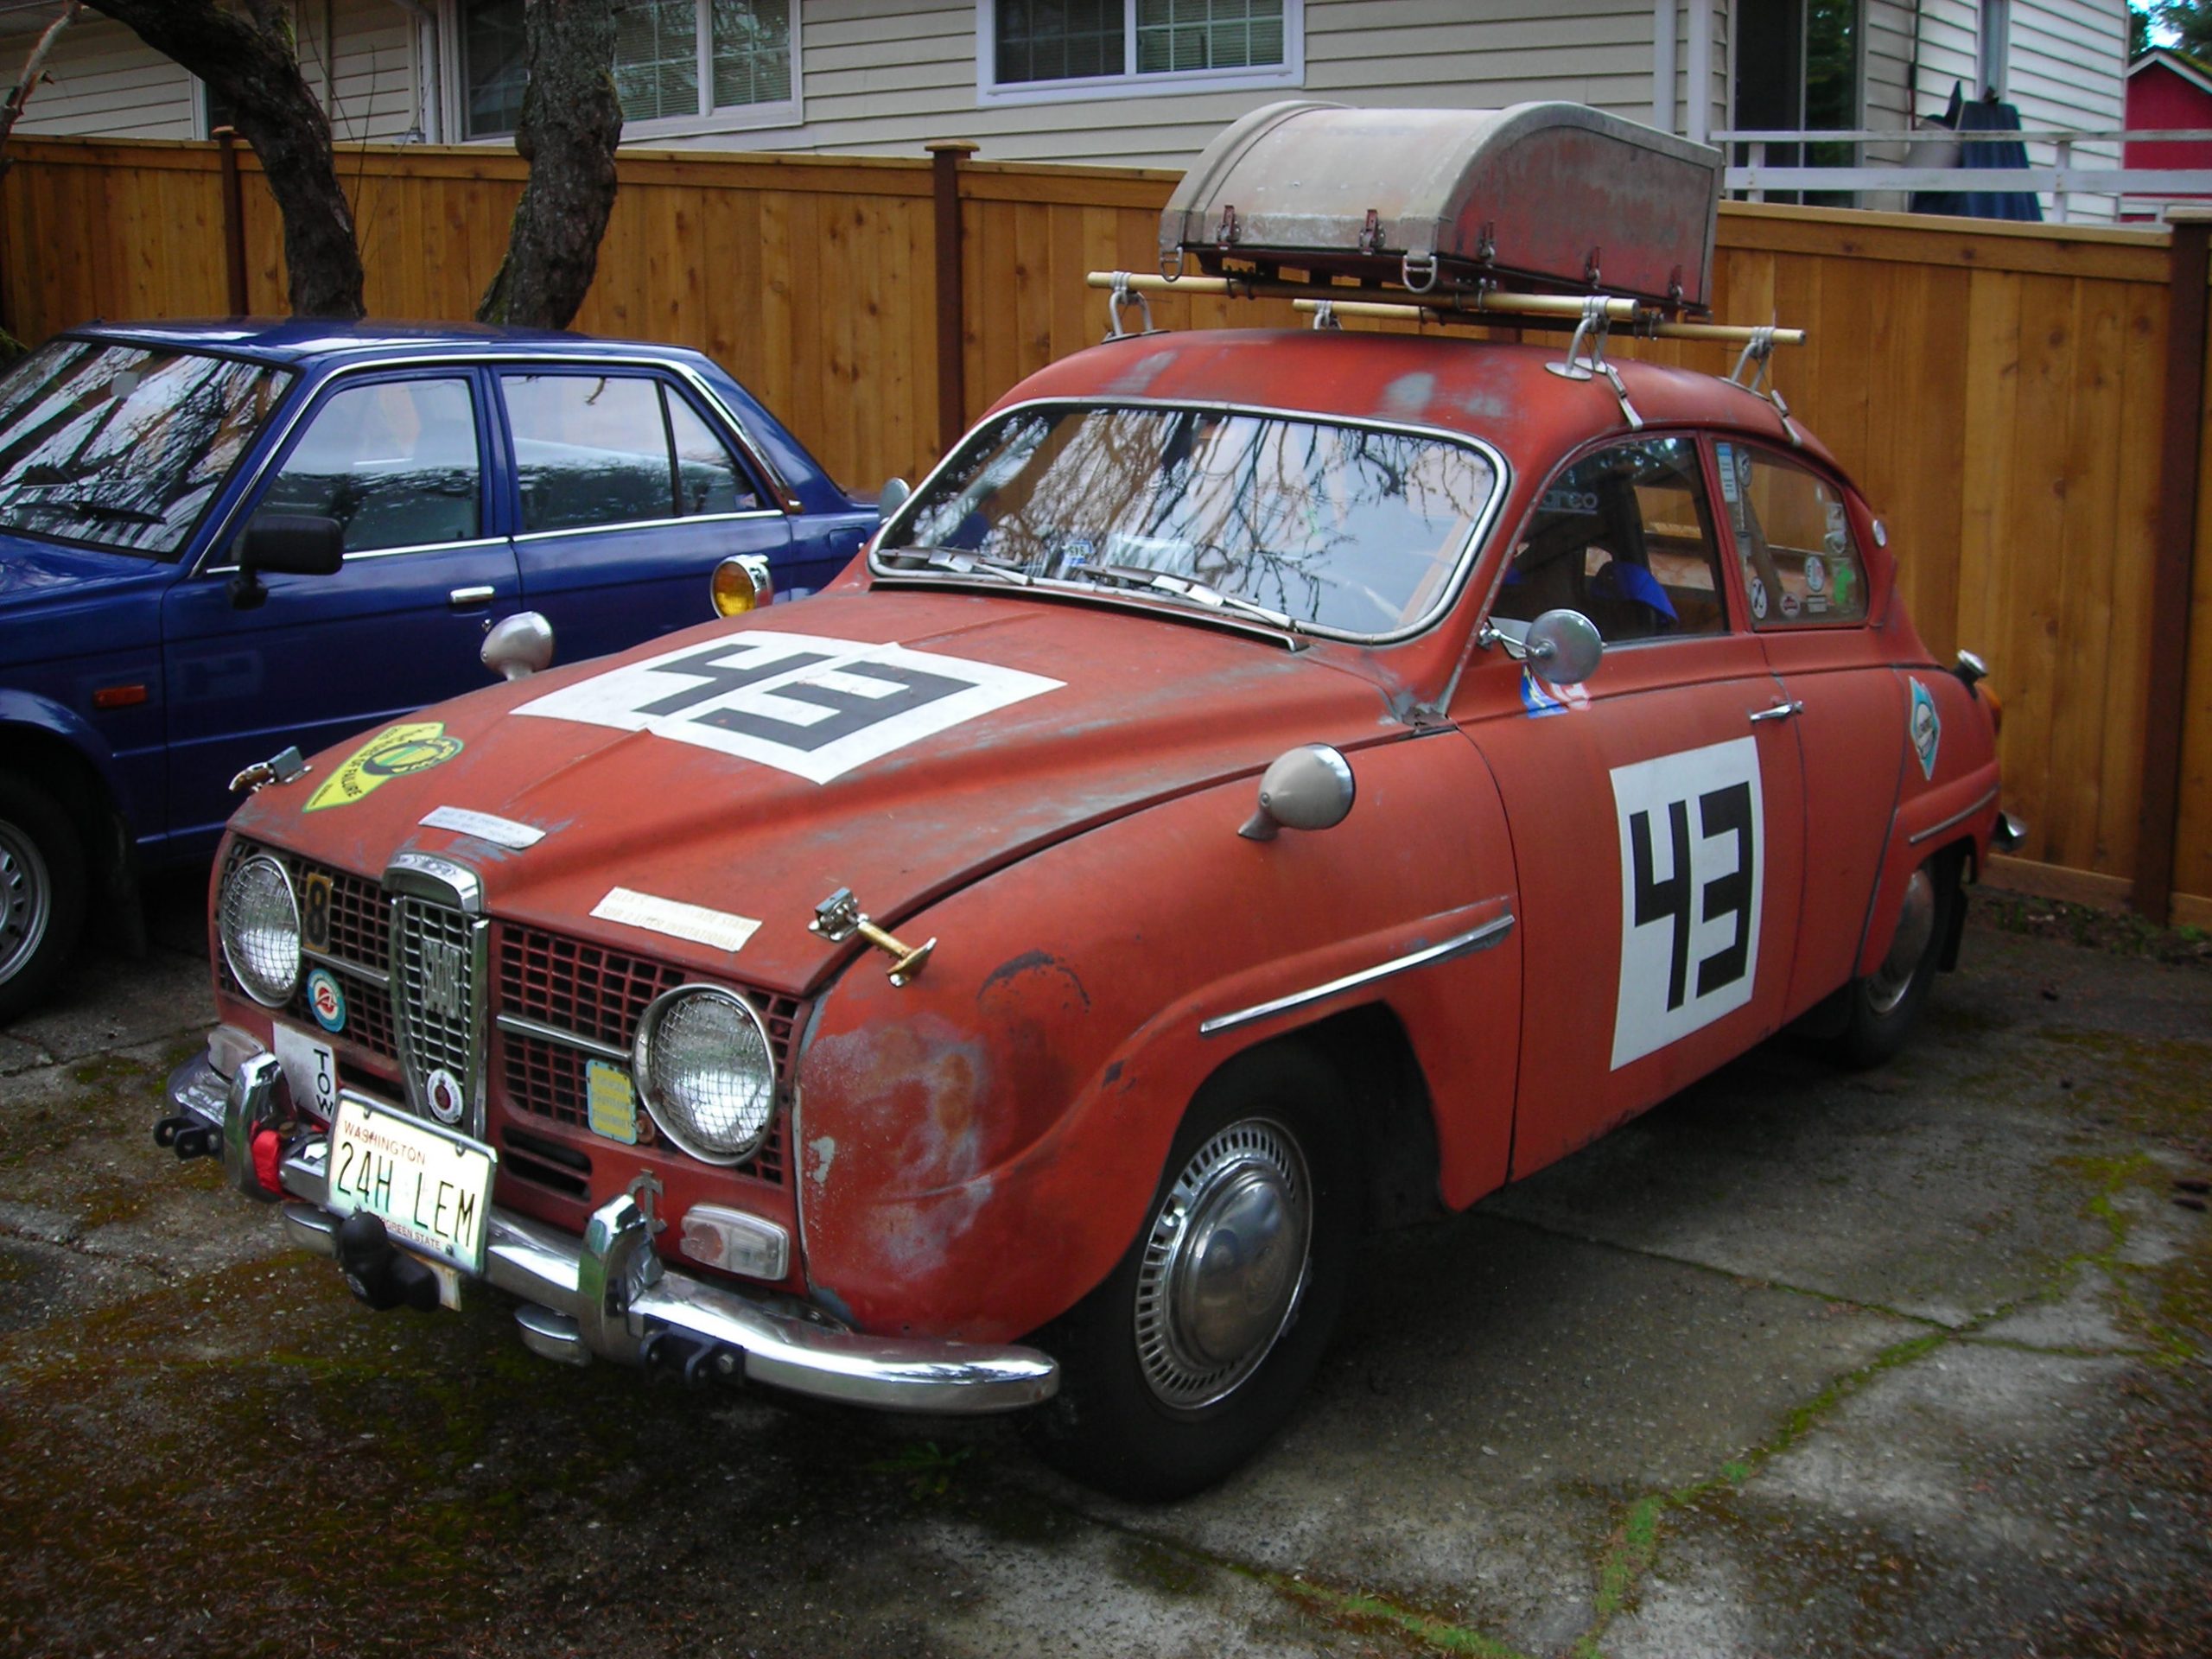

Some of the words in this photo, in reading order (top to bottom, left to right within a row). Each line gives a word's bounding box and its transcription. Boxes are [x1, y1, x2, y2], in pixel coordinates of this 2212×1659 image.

[631, 644, 980, 752] 43
[307, 880, 327, 946] 8
[1630, 781, 1754, 1013] 43
[314, 1048, 334, 1116] TOW
[344, 1121, 426, 1166] WASHINGTON
[337, 1141, 393, 1213] 24H
[414, 1172, 475, 1247] LEM
[415, 1231, 441, 1250] STATE
